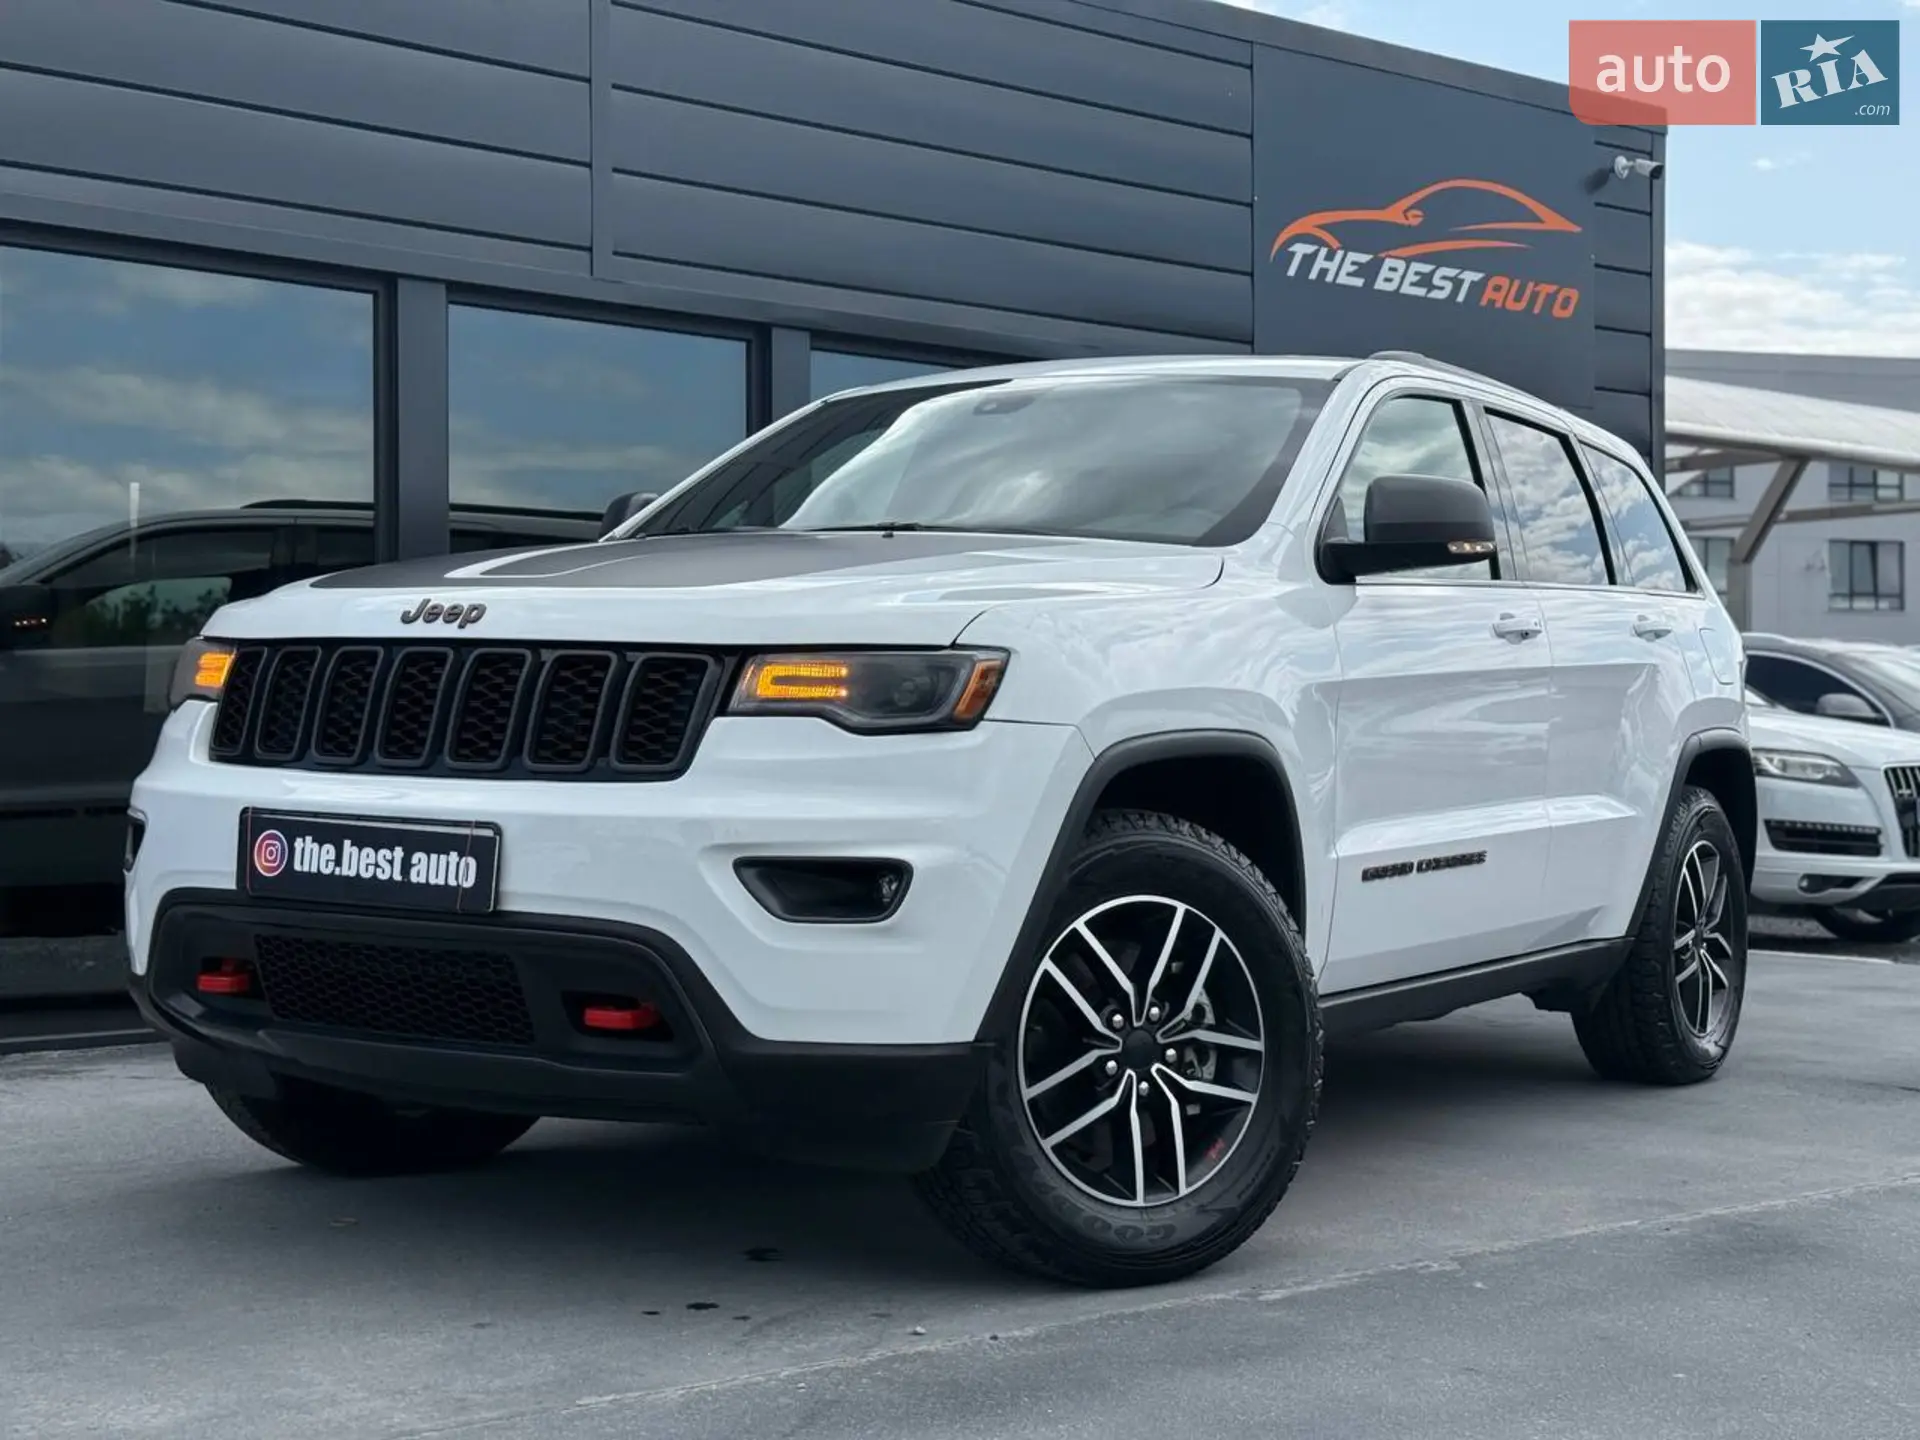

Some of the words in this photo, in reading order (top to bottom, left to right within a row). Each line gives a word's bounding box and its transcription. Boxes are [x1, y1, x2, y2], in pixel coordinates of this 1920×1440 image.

[1286, 242, 1374, 288] THE
[1373, 257, 1486, 303] BEST
[1479, 275, 1580, 319] AUTO
[400, 598, 487, 629] Jeep
[410, 850, 478, 889] auto
